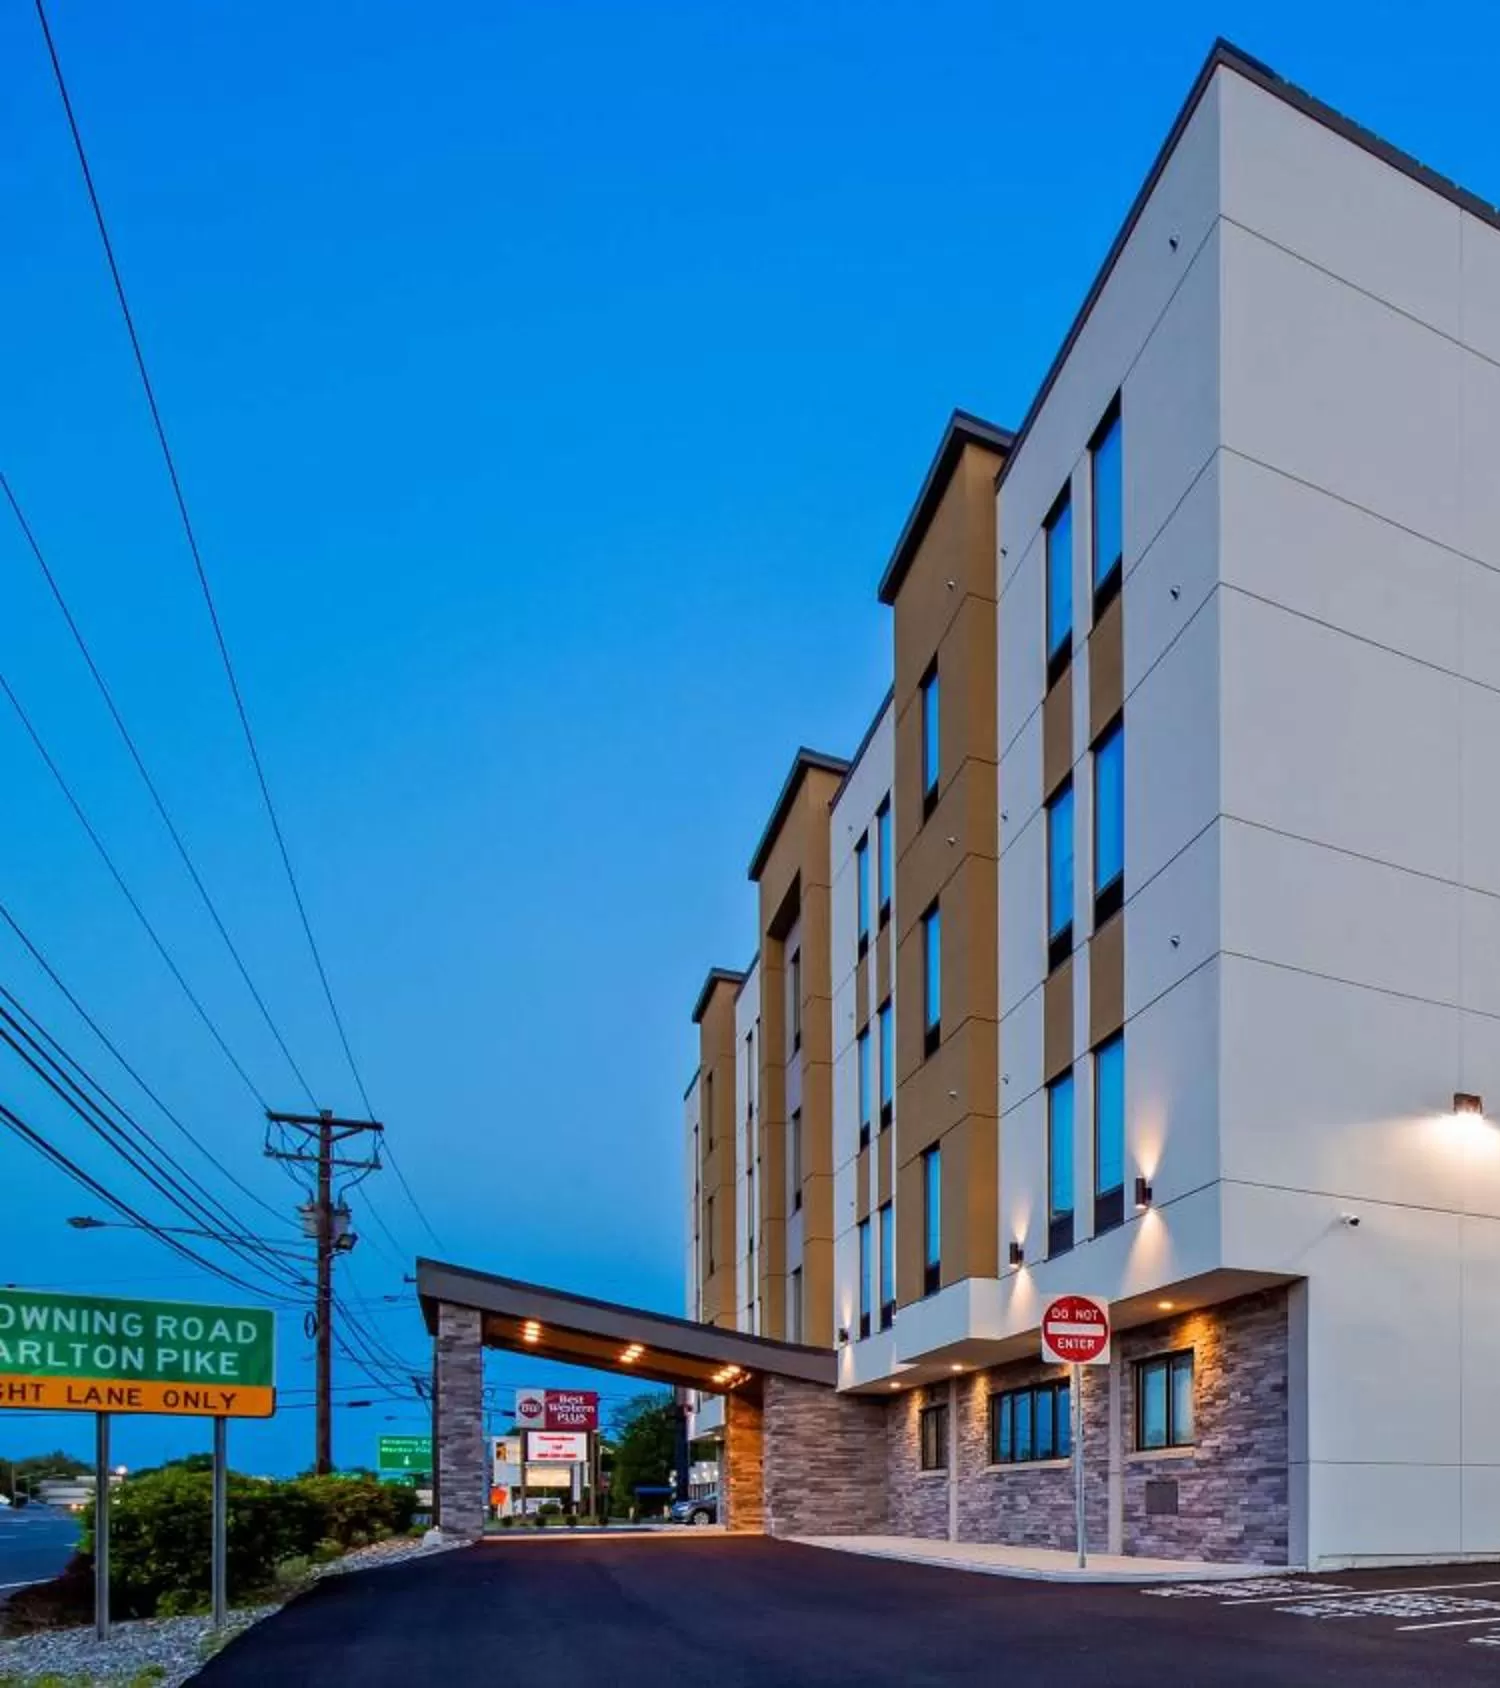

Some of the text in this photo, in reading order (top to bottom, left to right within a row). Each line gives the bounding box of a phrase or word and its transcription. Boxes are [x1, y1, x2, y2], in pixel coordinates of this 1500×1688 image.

[0, 1303, 257, 1344] OWNING ROAD
[1051, 1307, 1098, 1320] DO NOT
[1057, 1337, 1095, 1350] ENTER
[156, 1348, 239, 1376] PIKE
[67, 1384, 143, 1407] LANE
[162, 1389, 236, 1410] ONLY
